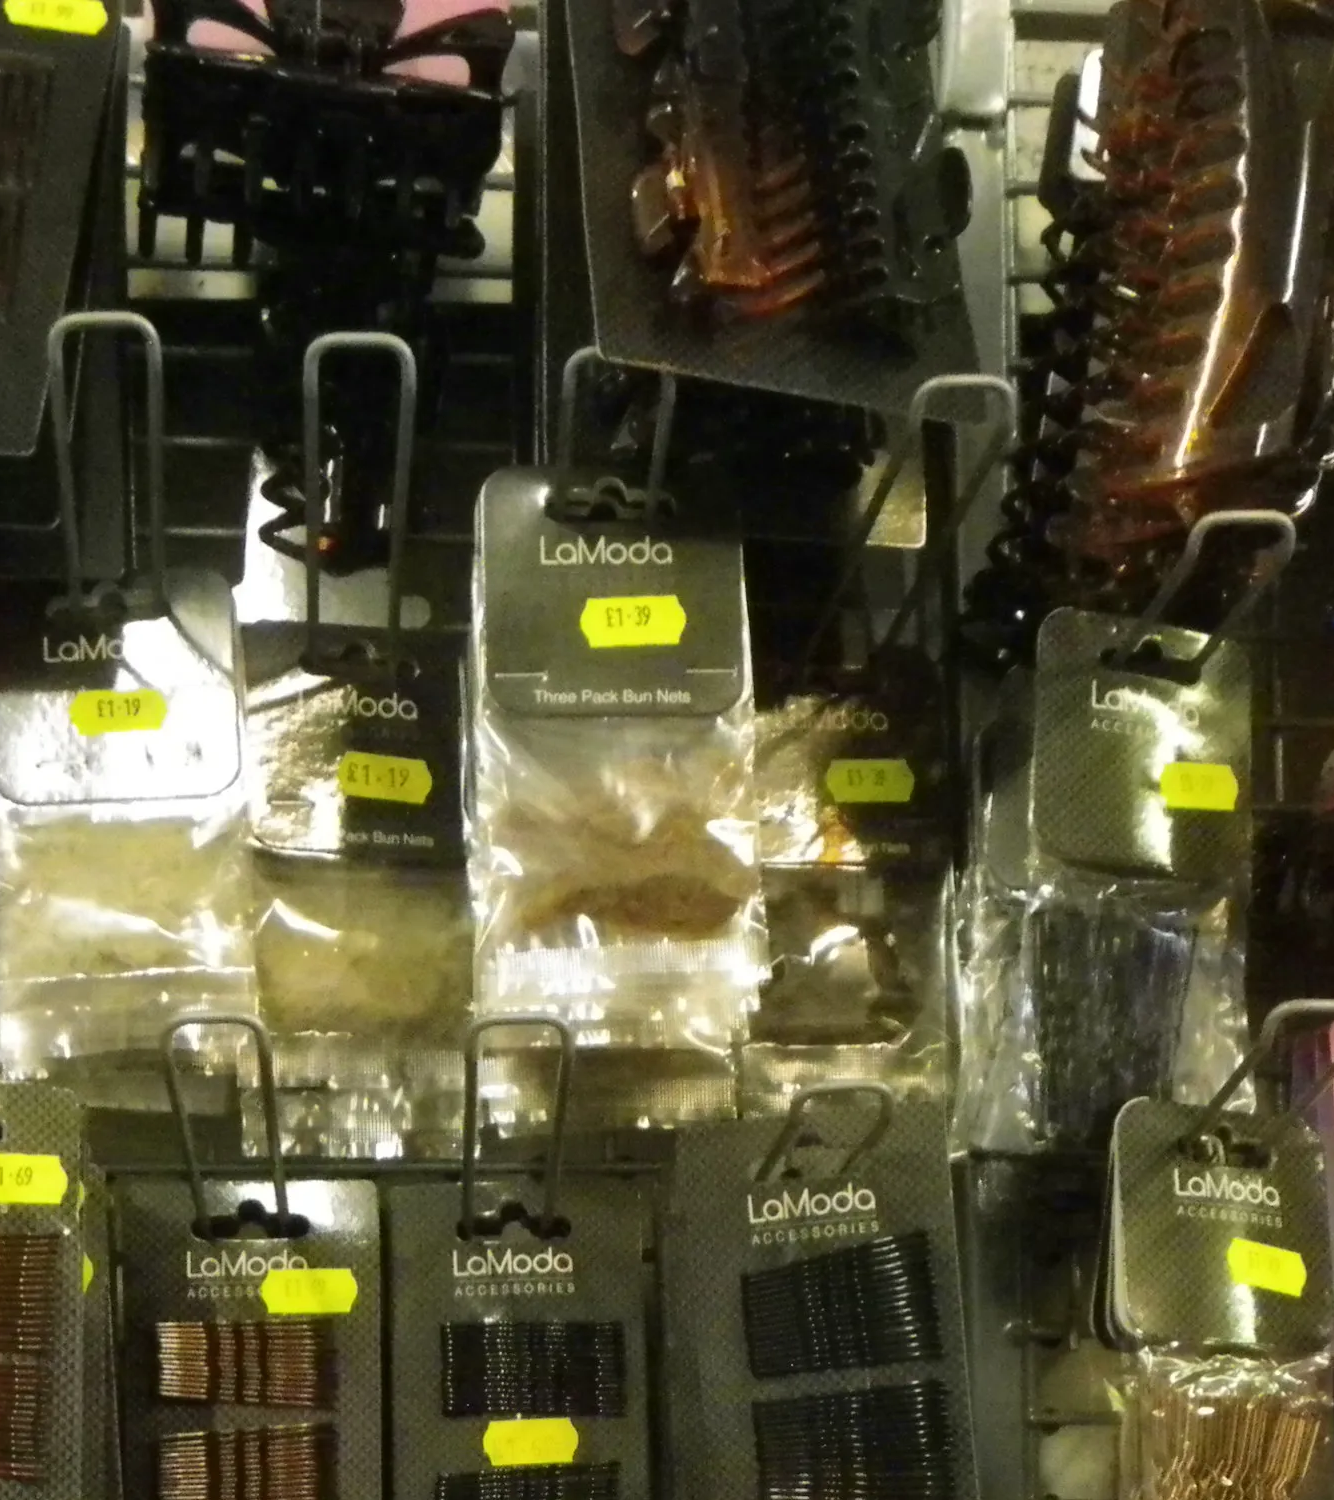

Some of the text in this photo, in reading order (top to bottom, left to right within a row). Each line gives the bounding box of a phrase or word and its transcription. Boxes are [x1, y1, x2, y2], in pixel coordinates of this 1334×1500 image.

[539, 533, 675, 566] LaModa
[534, 688, 692, 704] Three Pack Bun Nets
[373, 831, 401, 846] Bun
[402, 834, 435, 848] Nets
[748, 1182, 877, 1225] LaModa
[1174, 1171, 1282, 1209] LaModa
[1176, 1205, 1285, 1230] ACCESSORIES
[750, 1220, 882, 1246] ACCESSORIES
[186, 1248, 309, 1278] LaModa
[453, 1246, 575, 1276] LaModa
[454, 1281, 577, 1296] ACCESSORIES
